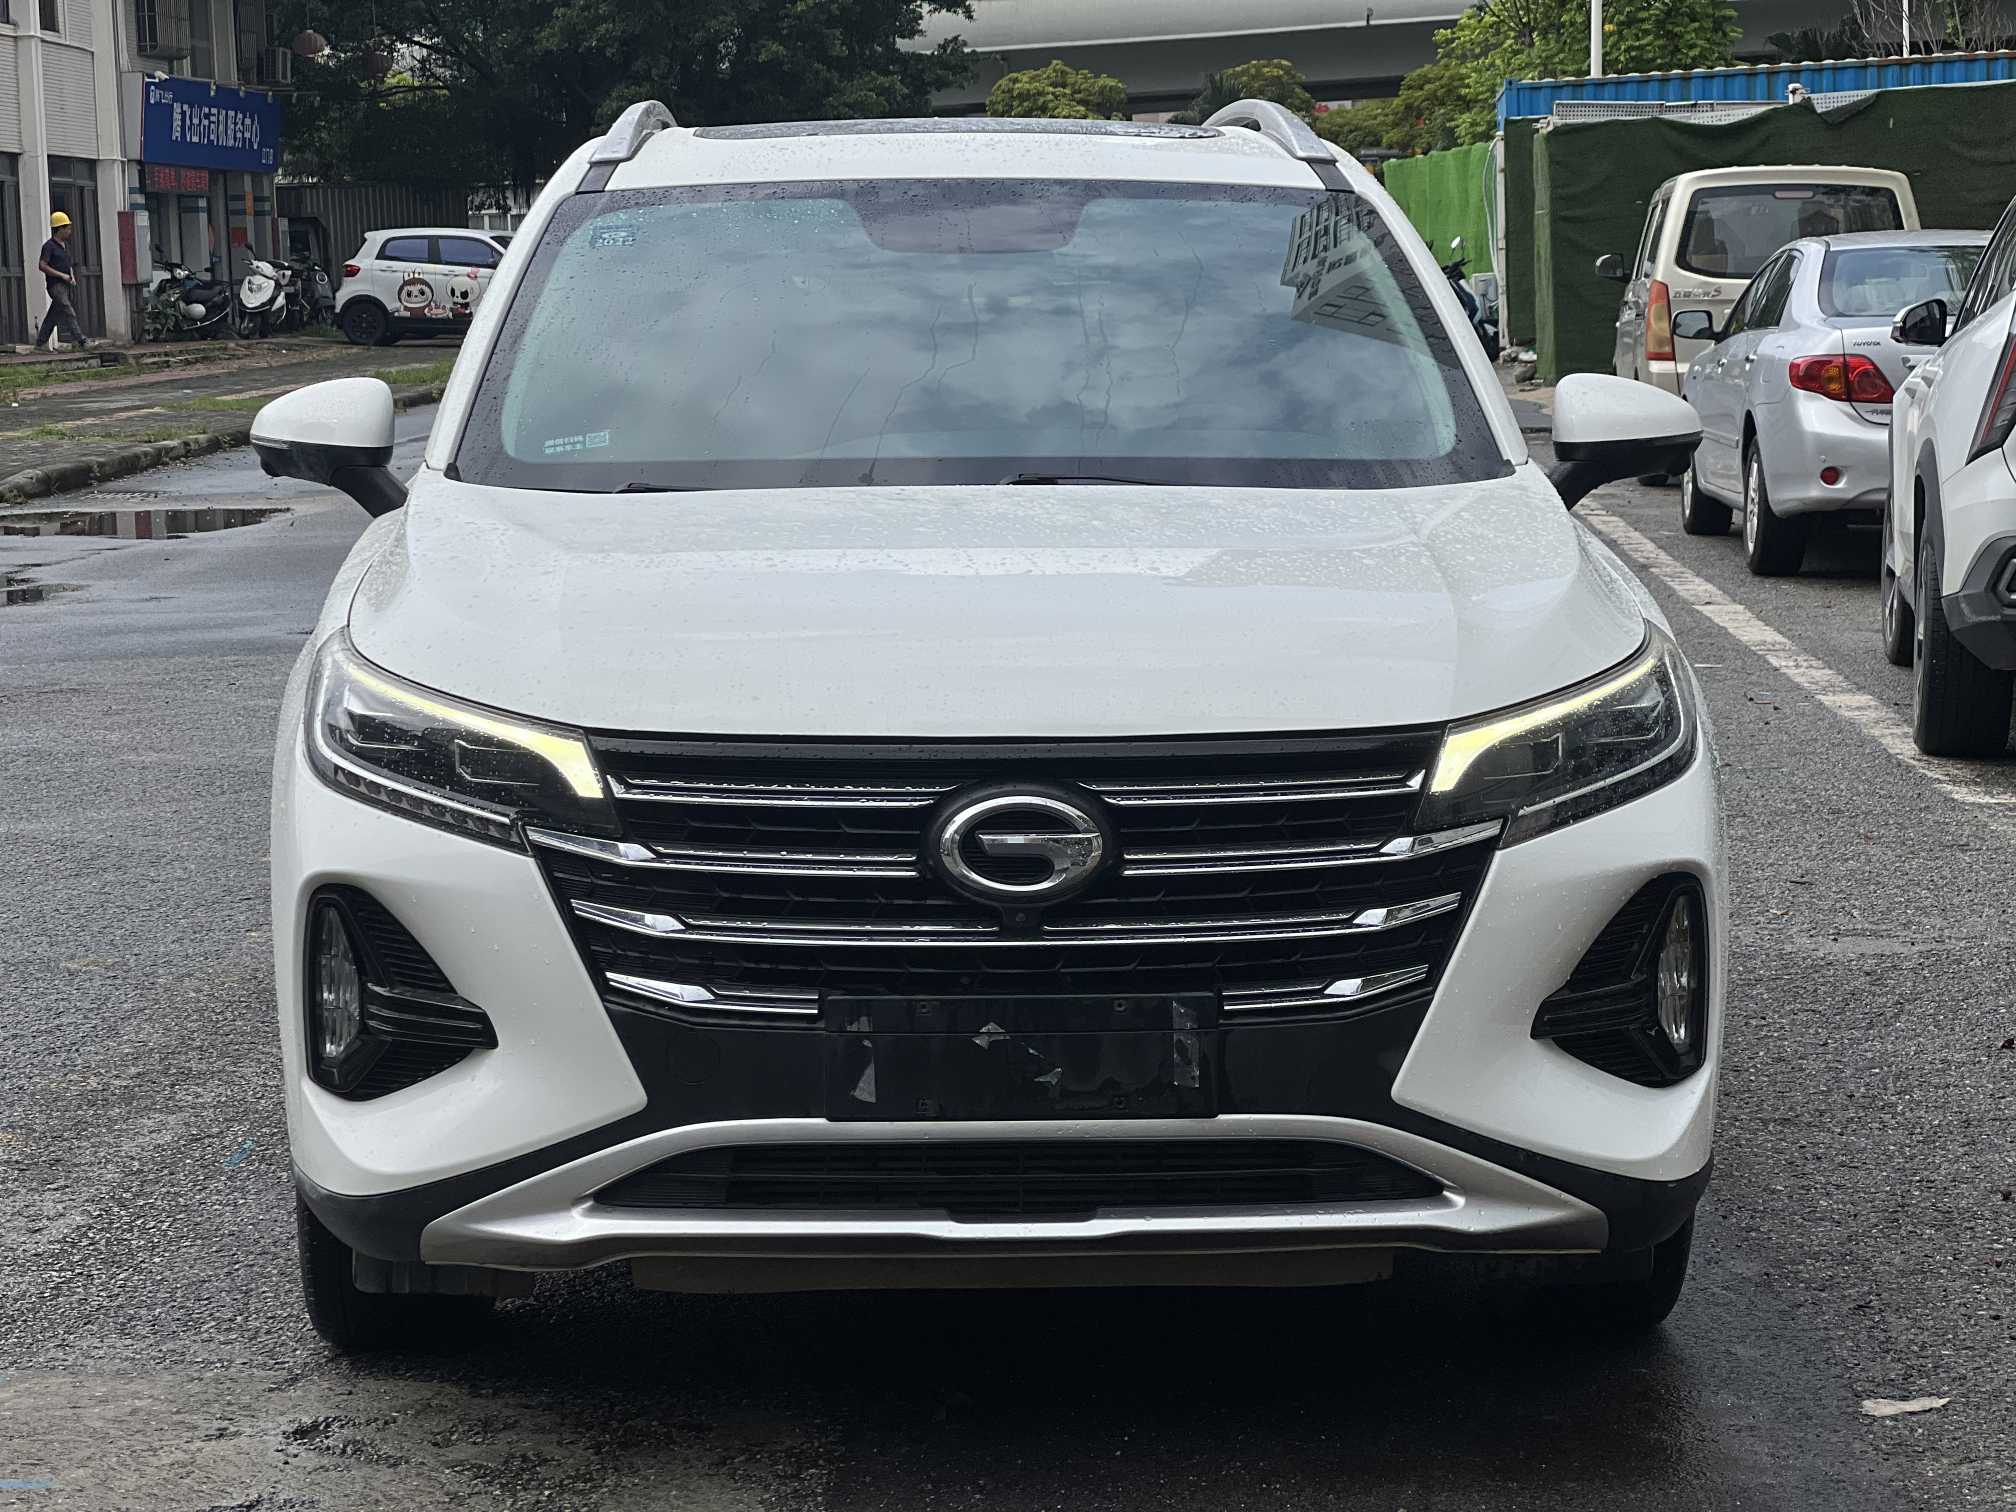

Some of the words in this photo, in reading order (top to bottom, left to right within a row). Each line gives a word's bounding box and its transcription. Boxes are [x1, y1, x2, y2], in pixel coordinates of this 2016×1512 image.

[171, 102, 260, 150] 腾飞出行司机服务中心
